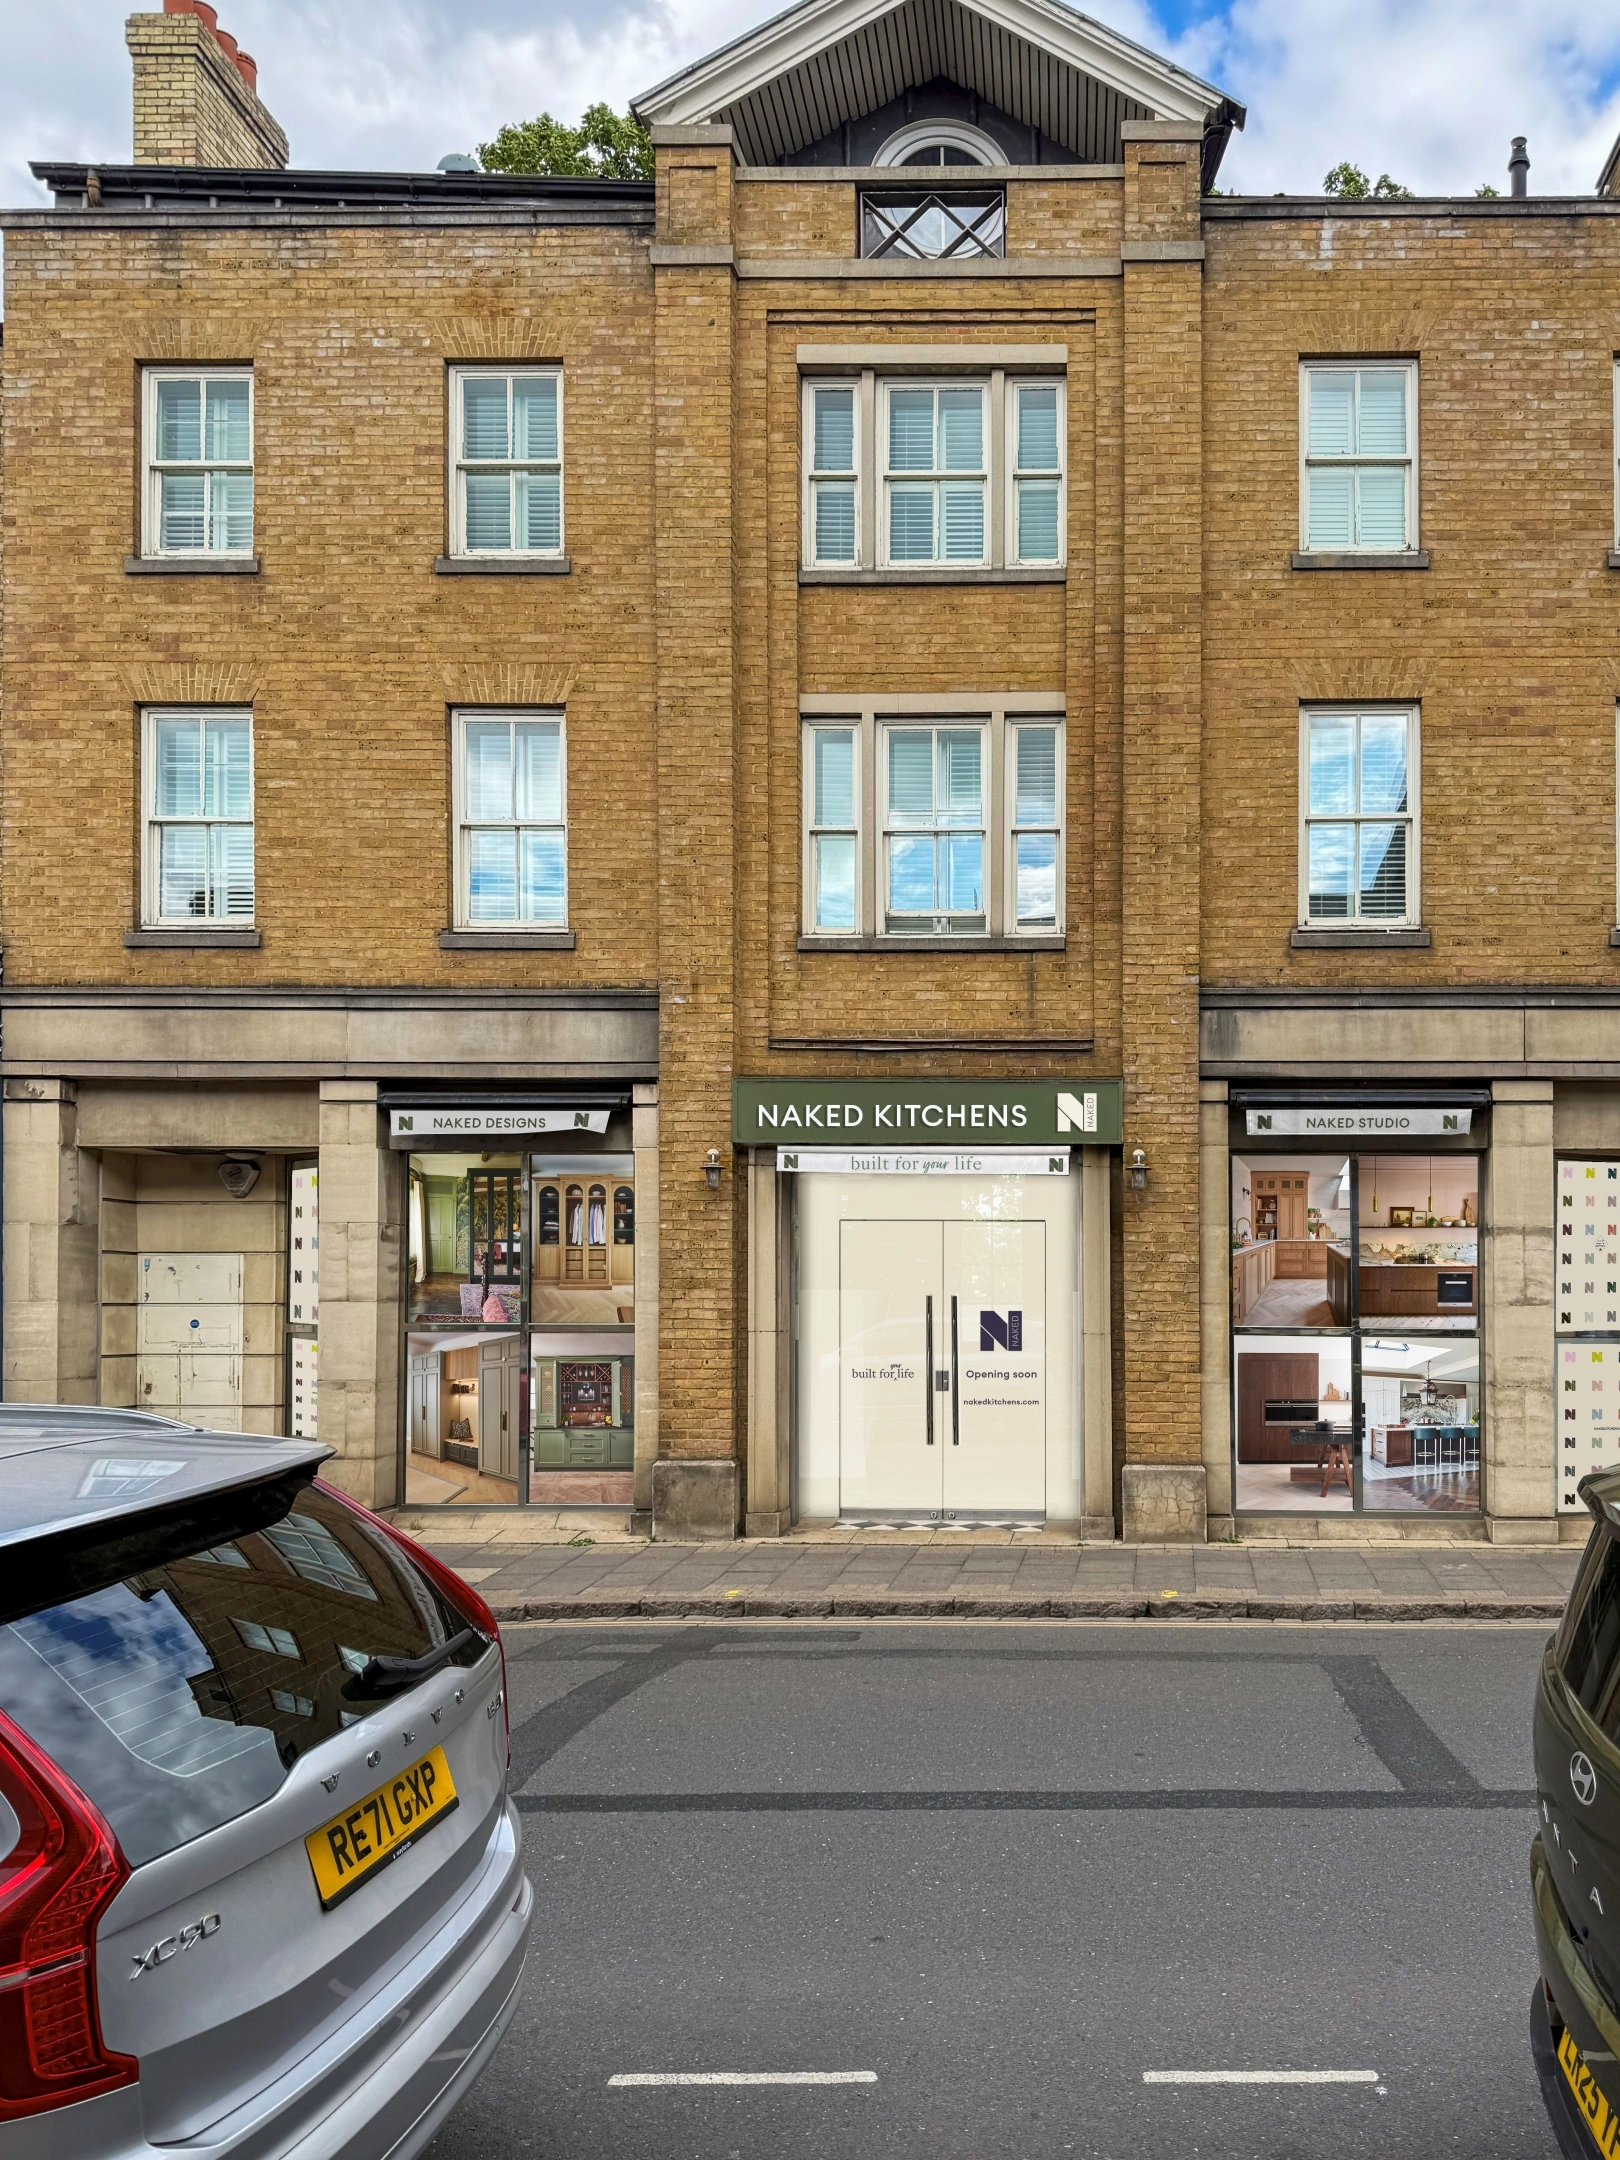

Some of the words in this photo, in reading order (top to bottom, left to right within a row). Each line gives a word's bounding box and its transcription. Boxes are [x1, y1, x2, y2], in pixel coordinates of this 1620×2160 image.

[399, 1116, 413, 1130] N
[433, 1117, 482, 1129] NAKED
[486, 1117, 546, 1129] DESIGNS
[574, 1113, 589, 1127] N
[757, 1104, 864, 1127] NAKED
[875, 1104, 1028, 1127] KITCHENS
[1257, 1115, 1272, 1129] N
[1306, 1117, 1355, 1129] NAKED
[1358, 1117, 1410, 1129] STUDIO
[1443, 1115, 1457, 1129] N
[783, 1154, 798, 1169] N
[851, 1156, 889, 1170] built
[896, 1156, 919, 1170] for
[923, 1160, 950, 1173] your
[955, 1156, 982, 1170] life
[1049, 1158, 1063, 1172] N
[1011, 1315, 1019, 1346] NAKED
[851, 1368, 877, 1379] built
[879, 1368, 896, 1379] for
[897, 1368, 915, 1379] life
[966, 1369, 1010, 1381] Opening
[1012, 1371, 1038, 1379] soon
[963, 1398, 1040, 1406] nakedkitchens.com
[320, 1688, 465, 1793] VOLVO
[327, 1793, 394, 1876] RE71
[392, 1760, 436, 1826] GXP
[130, 1912, 221, 1980] XC90
